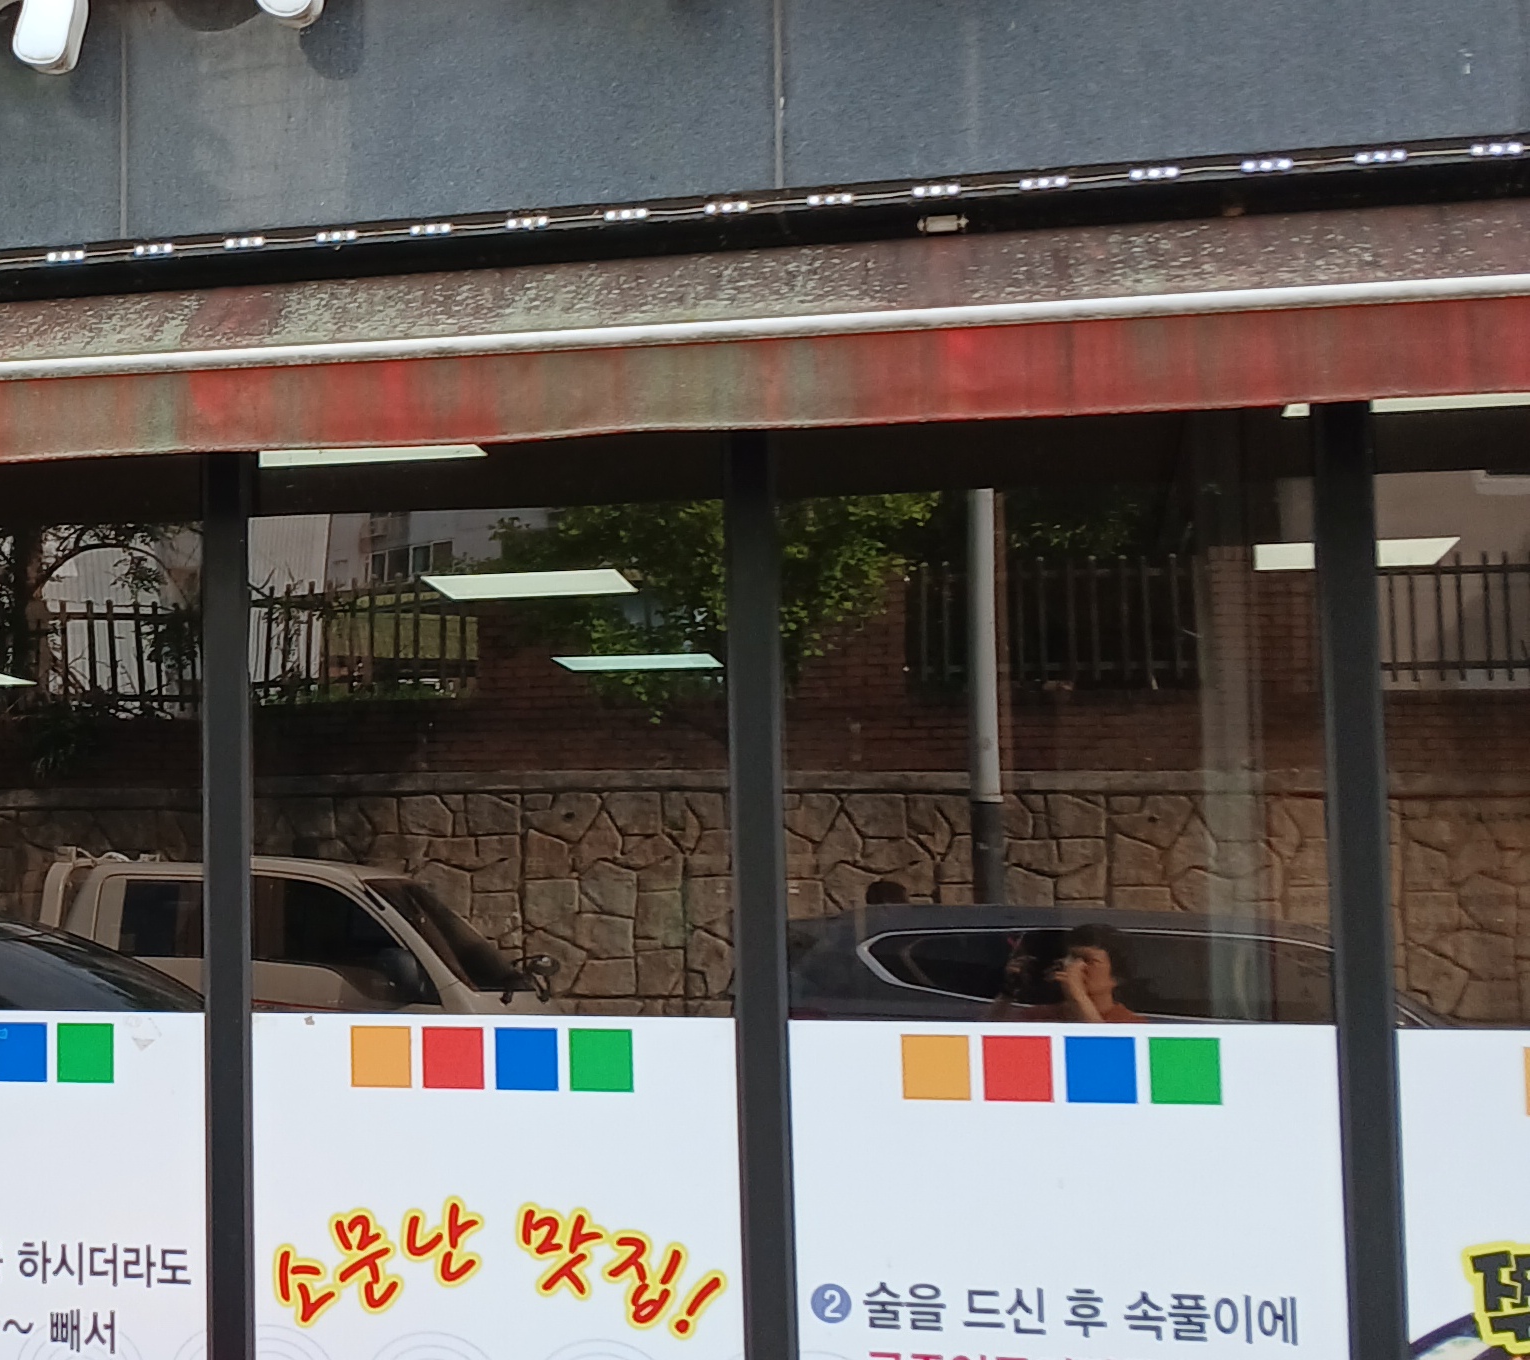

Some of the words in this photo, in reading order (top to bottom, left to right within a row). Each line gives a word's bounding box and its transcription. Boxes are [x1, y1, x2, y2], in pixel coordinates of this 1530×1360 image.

[17, 1241, 192, 1287] 하시더라도
[277, 1200, 481, 1323] 소문난
[520, 1206, 722, 1335] 맛집!
[49, 1309, 117, 1354] 빼서
[863, 1282, 947, 1332] 술을
[963, 1287, 1047, 1336] 드신
[1064, 1289, 1108, 1339] 후
[1123, 1291, 1299, 1346] 속풀이에
